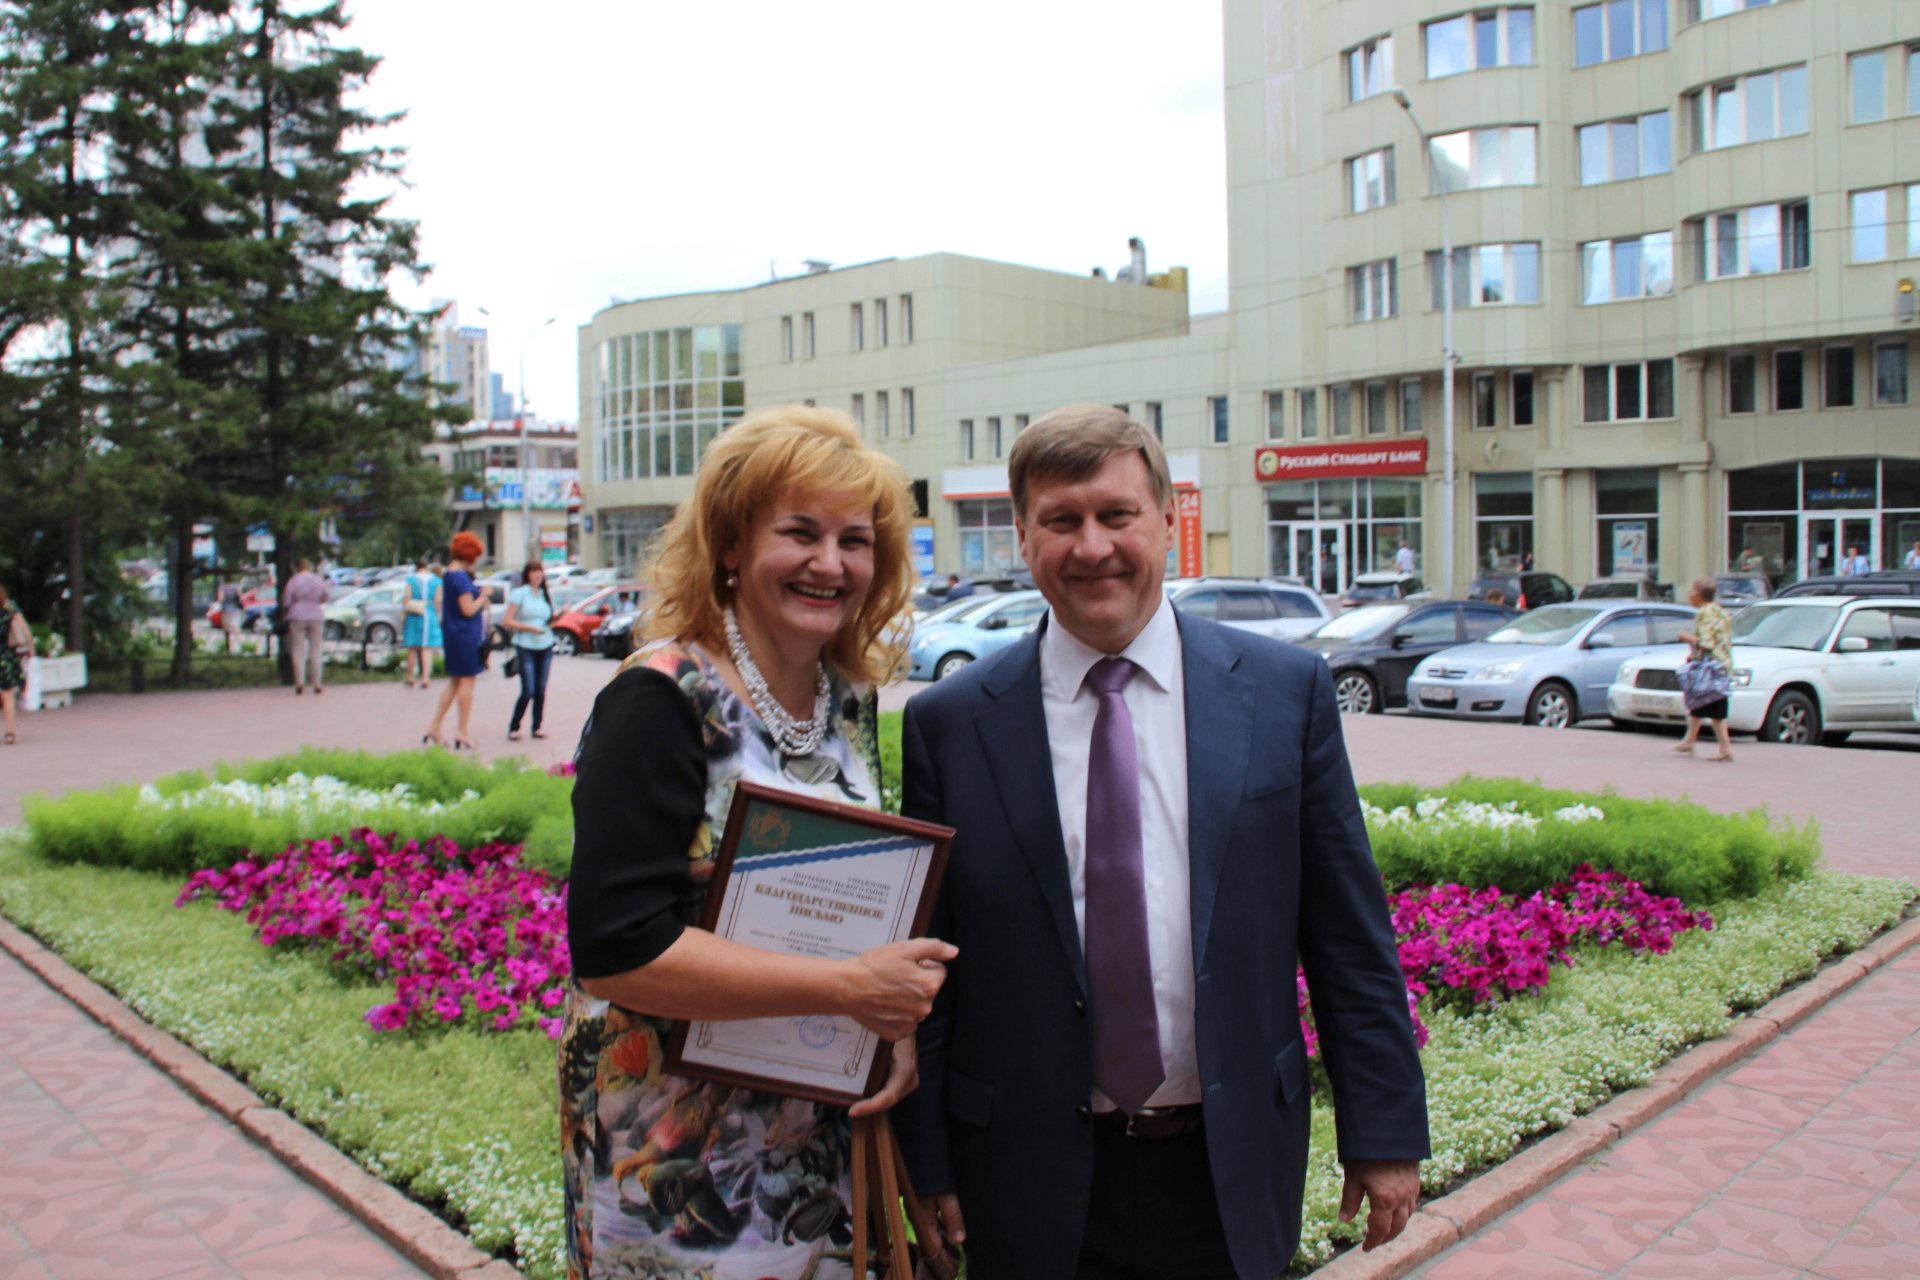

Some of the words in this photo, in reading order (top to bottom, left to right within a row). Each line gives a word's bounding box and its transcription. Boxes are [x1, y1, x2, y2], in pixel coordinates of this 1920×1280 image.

[1330, 452, 1388, 467] СТАНДАРТ
[1389, 450, 1422, 463] БАНК
[1180, 492, 1199, 509] 24
[753, 883, 885, 920] БЛАГОДАРСТВЕННОЕ
[788, 904, 844, 925] ПИСЬМО
